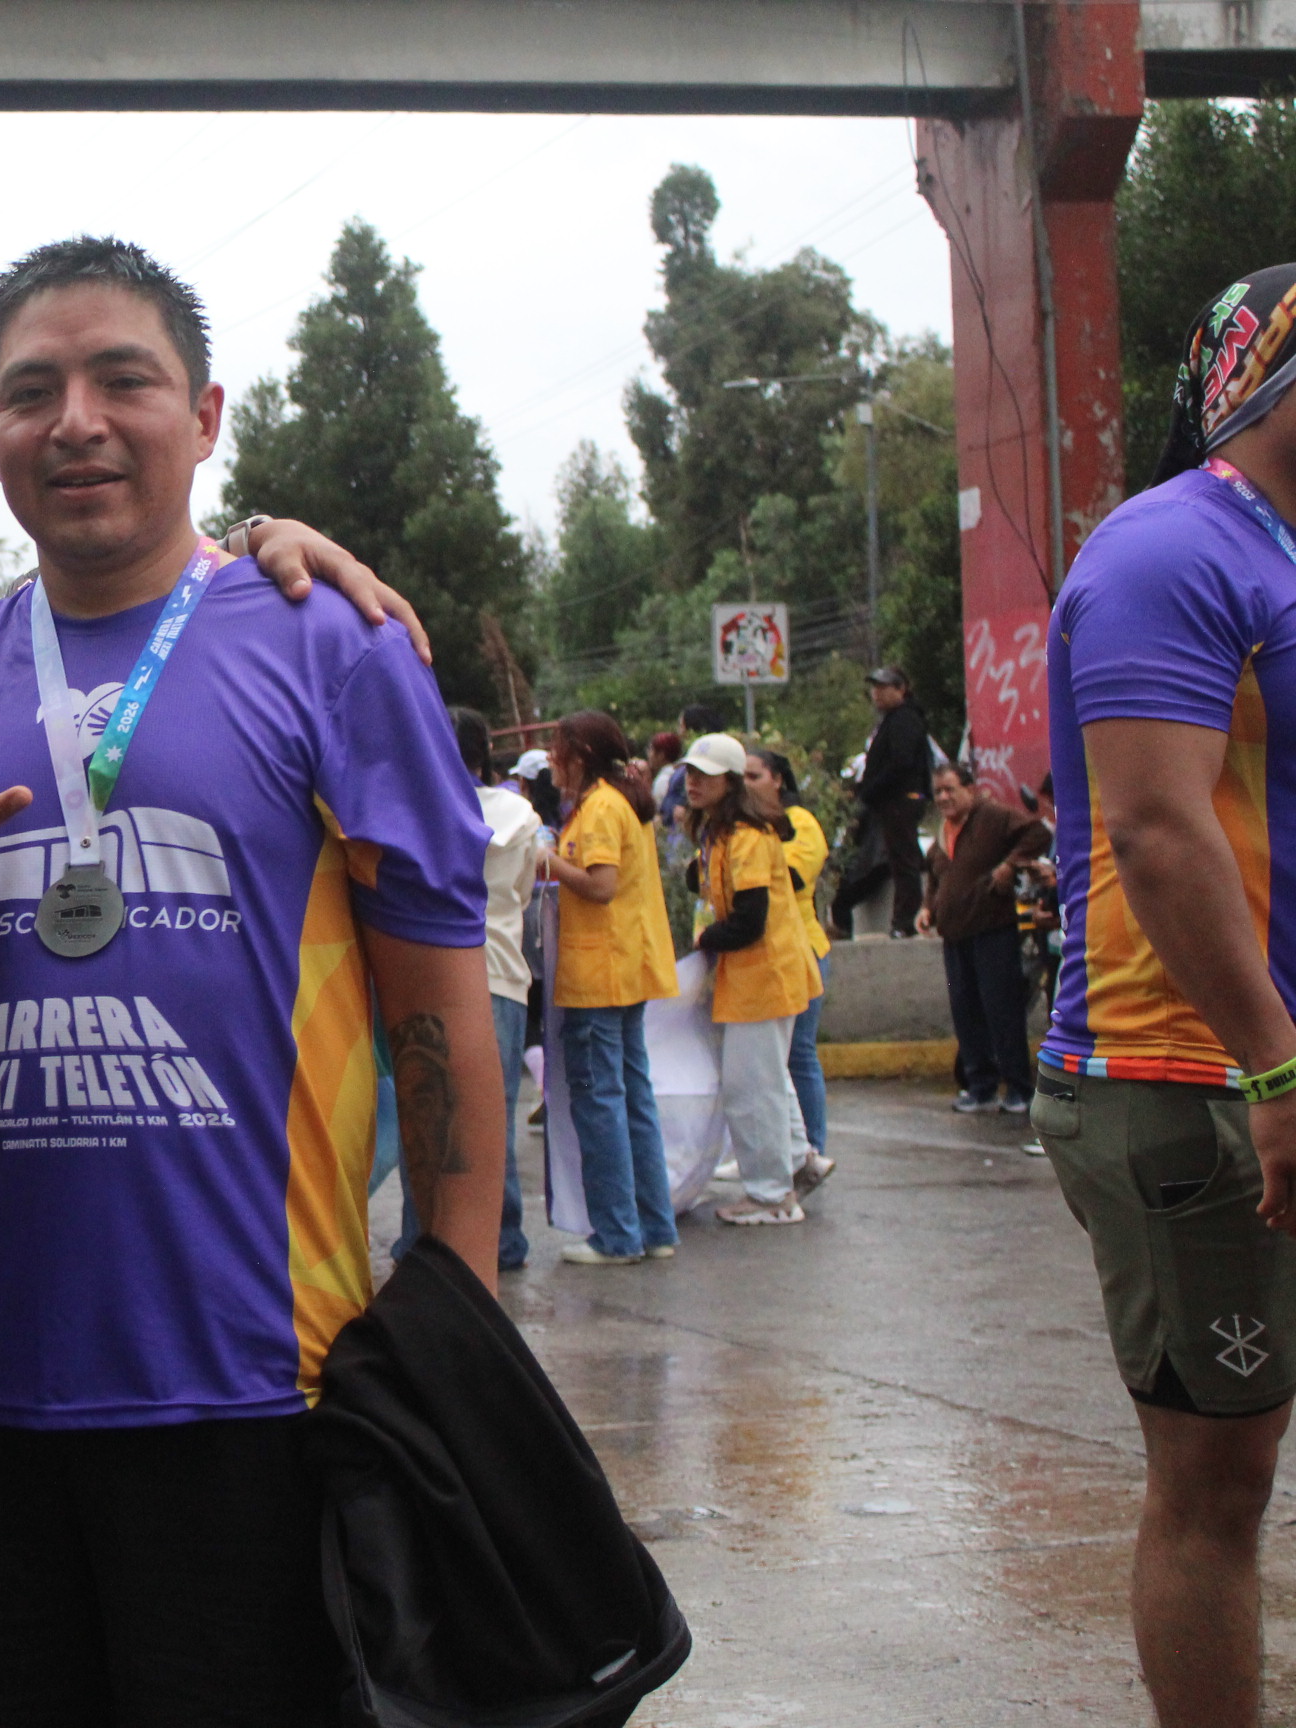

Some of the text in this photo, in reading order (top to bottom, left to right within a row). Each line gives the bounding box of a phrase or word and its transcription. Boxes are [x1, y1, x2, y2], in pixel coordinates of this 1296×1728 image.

[191, 558, 212, 582] 2026
[117, 701, 140, 734] 2026
[39, 1053, 229, 1109] TELETÓN
[32, 1116, 59, 1126] 10KM
[136, 1115, 145, 1126] 5
[147, 1115, 169, 1126] KM
[178, 1113, 236, 1127] 2026
[2, 1137, 127, 1150] CAMINATA SOLIDARIA 1 KM
